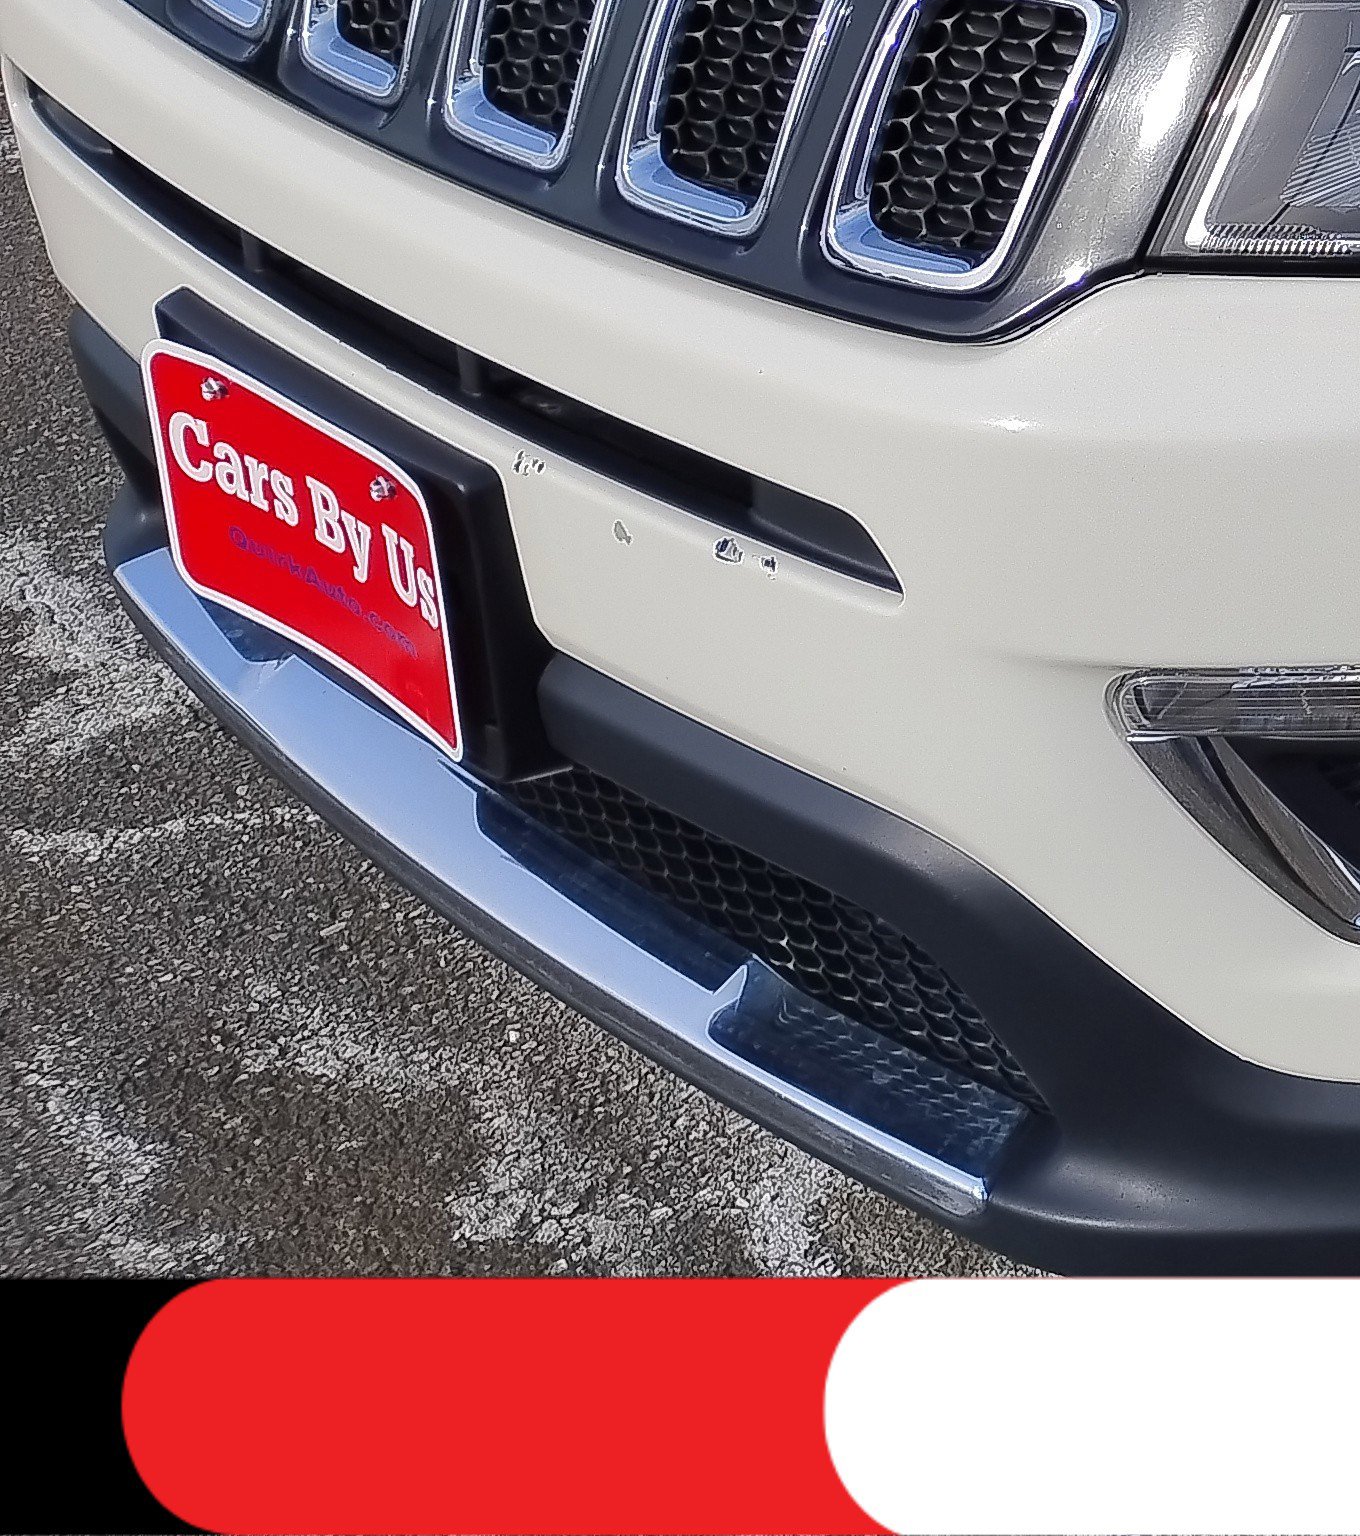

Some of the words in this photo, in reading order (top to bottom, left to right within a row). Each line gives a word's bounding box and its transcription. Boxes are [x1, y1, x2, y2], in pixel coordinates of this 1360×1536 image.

[168, 412, 299, 527] Cars
[307, 476, 372, 583] By
[382, 523, 438, 630] Us
